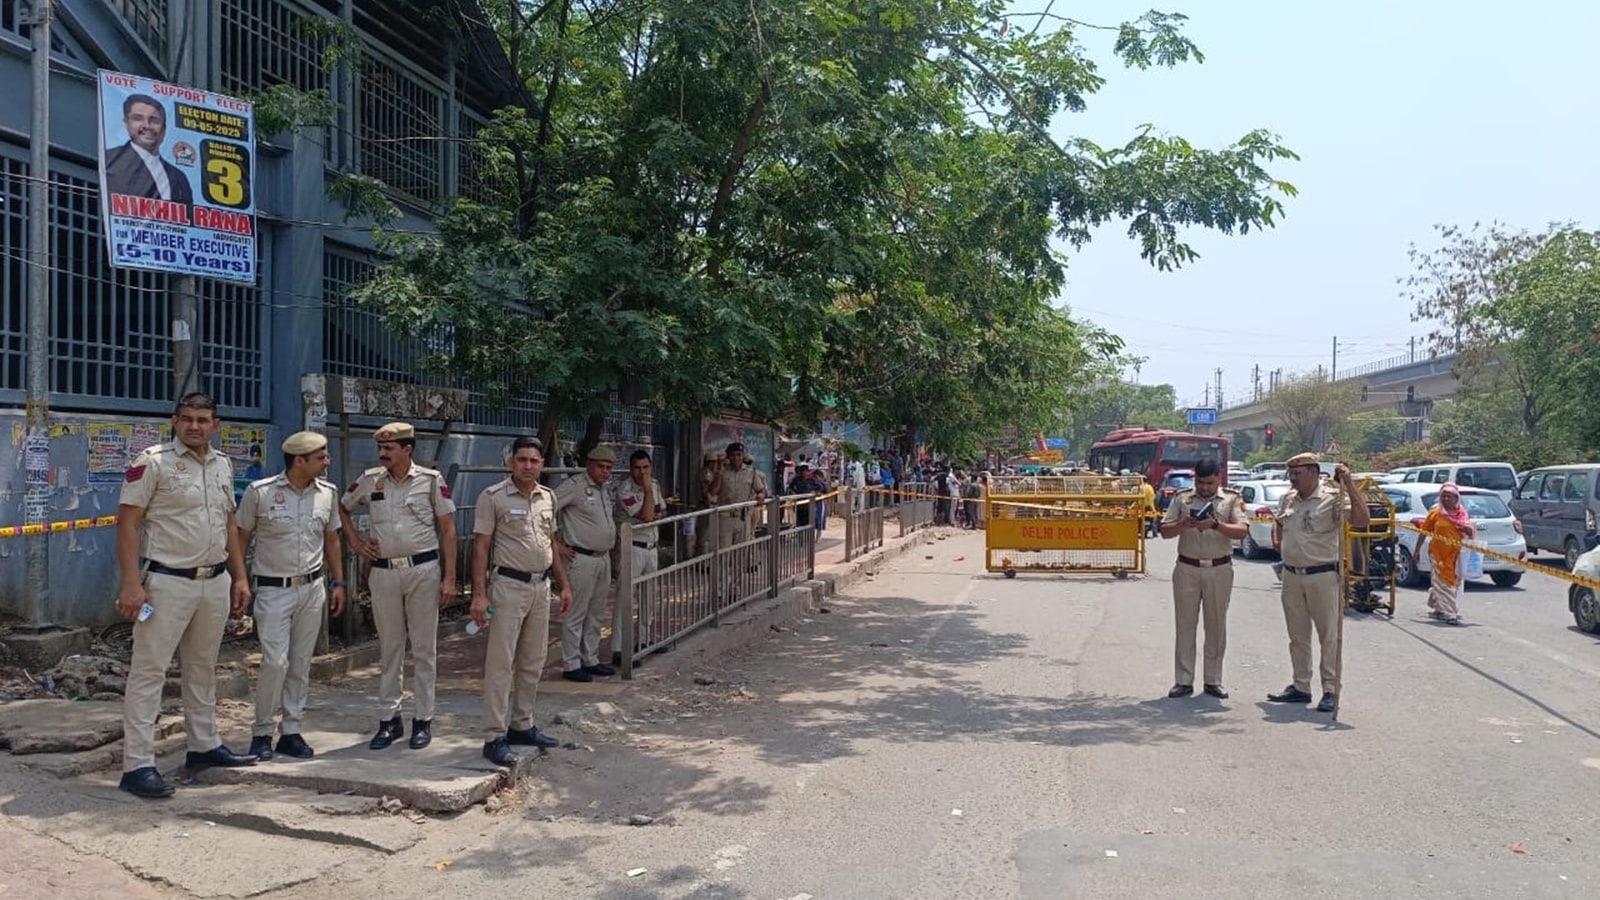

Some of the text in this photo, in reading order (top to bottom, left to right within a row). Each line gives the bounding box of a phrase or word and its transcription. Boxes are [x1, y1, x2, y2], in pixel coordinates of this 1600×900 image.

[105, 75, 250, 113] VOTE SUPPORT ELECT
[183, 117, 241, 138] 09-05-2025
[206, 159, 244, 206] 3
[111, 193, 191, 226] NIKHIL
[193, 204, 252, 236] RANA
[130, 228, 186, 251] MEMBER
[189, 238, 249, 260] EXECUTIVE
[1057, 527, 1099, 540] POLICE
